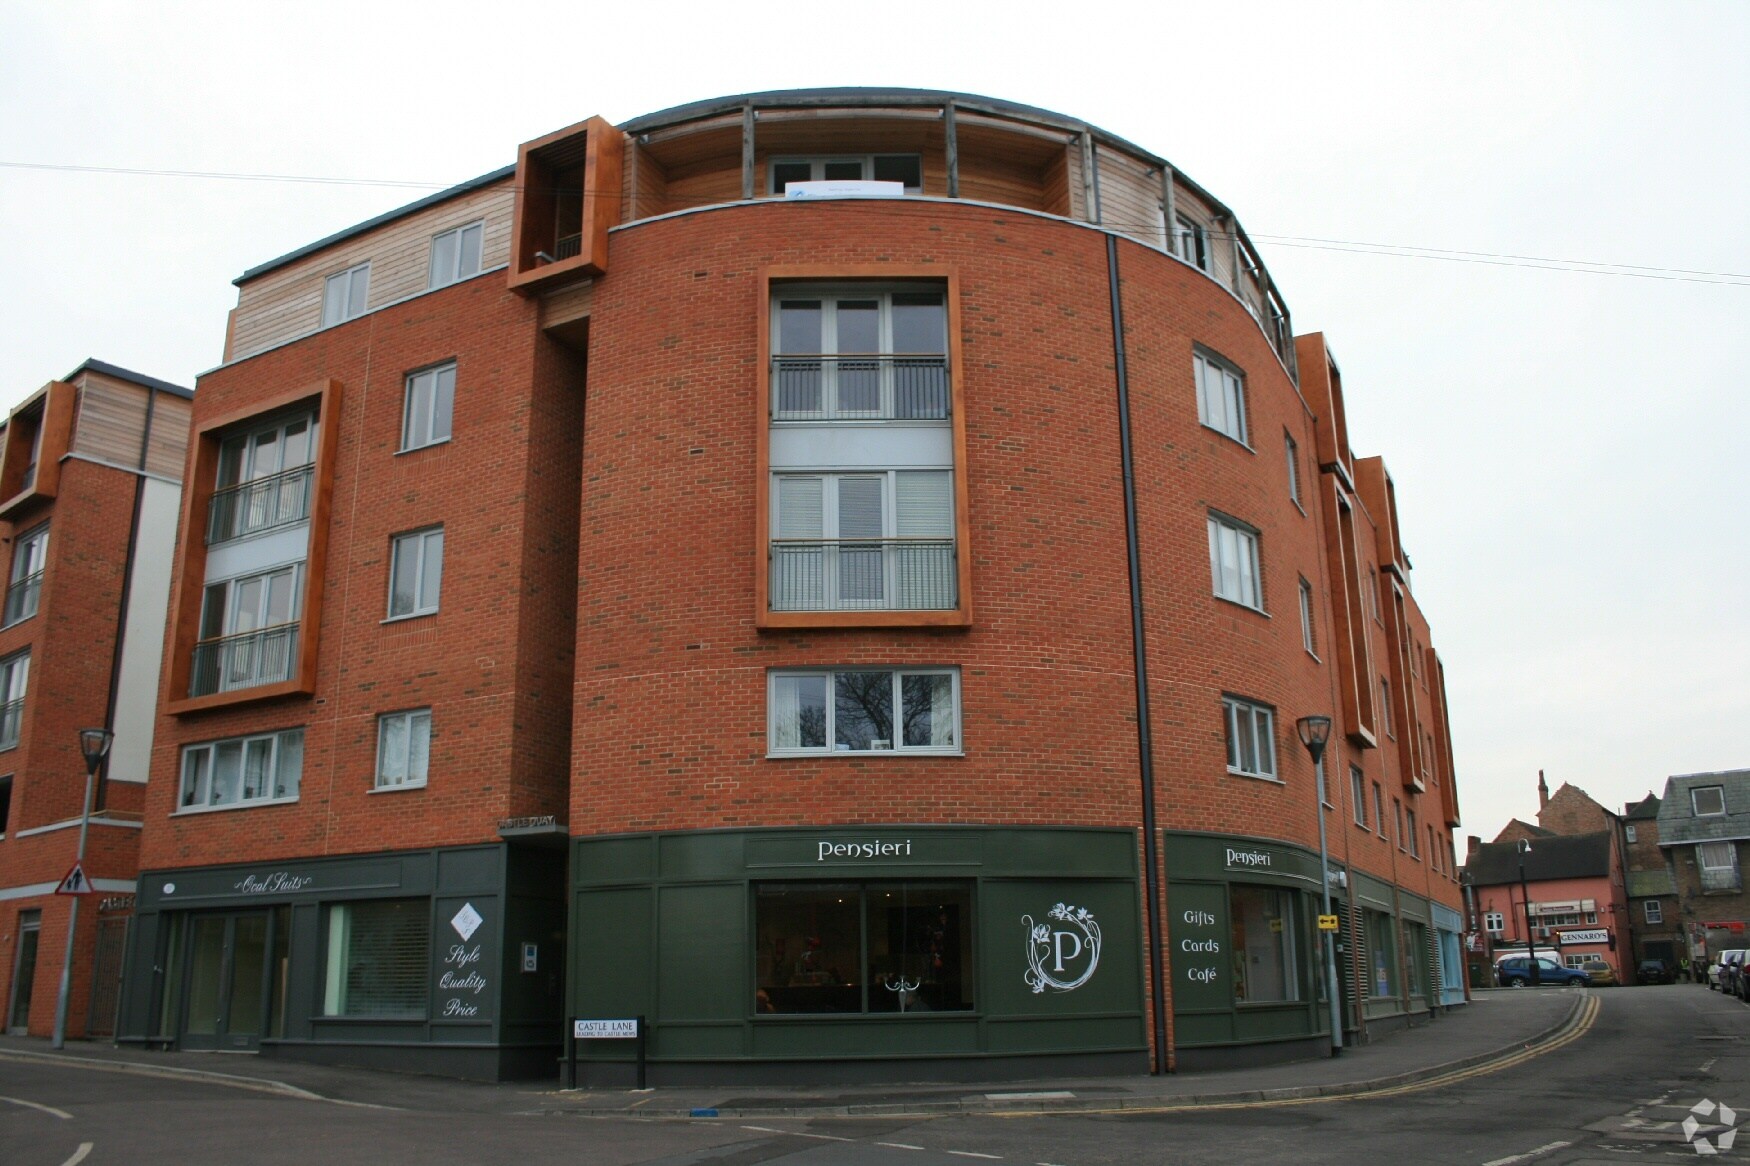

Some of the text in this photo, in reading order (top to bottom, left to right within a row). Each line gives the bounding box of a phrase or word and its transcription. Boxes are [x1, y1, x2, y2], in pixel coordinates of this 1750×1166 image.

[817, 839, 911, 861] Pensieri
[1226, 848, 1271, 867] Pensieri
[269, 871, 302, 892] Suits
[1183, 910, 1215, 927] Gifts
[1181, 938, 1219, 953] Cards
[1561, 931, 1607, 942] GENNARO'S
[444, 944, 481, 969] Style
[1053, 931, 1082, 971] P
[439, 970, 486, 994] Quality
[1187, 966, 1217, 984] Café
[442, 998, 478, 1017] Price
[578, 1022, 633, 1031] CASTLE LANE
